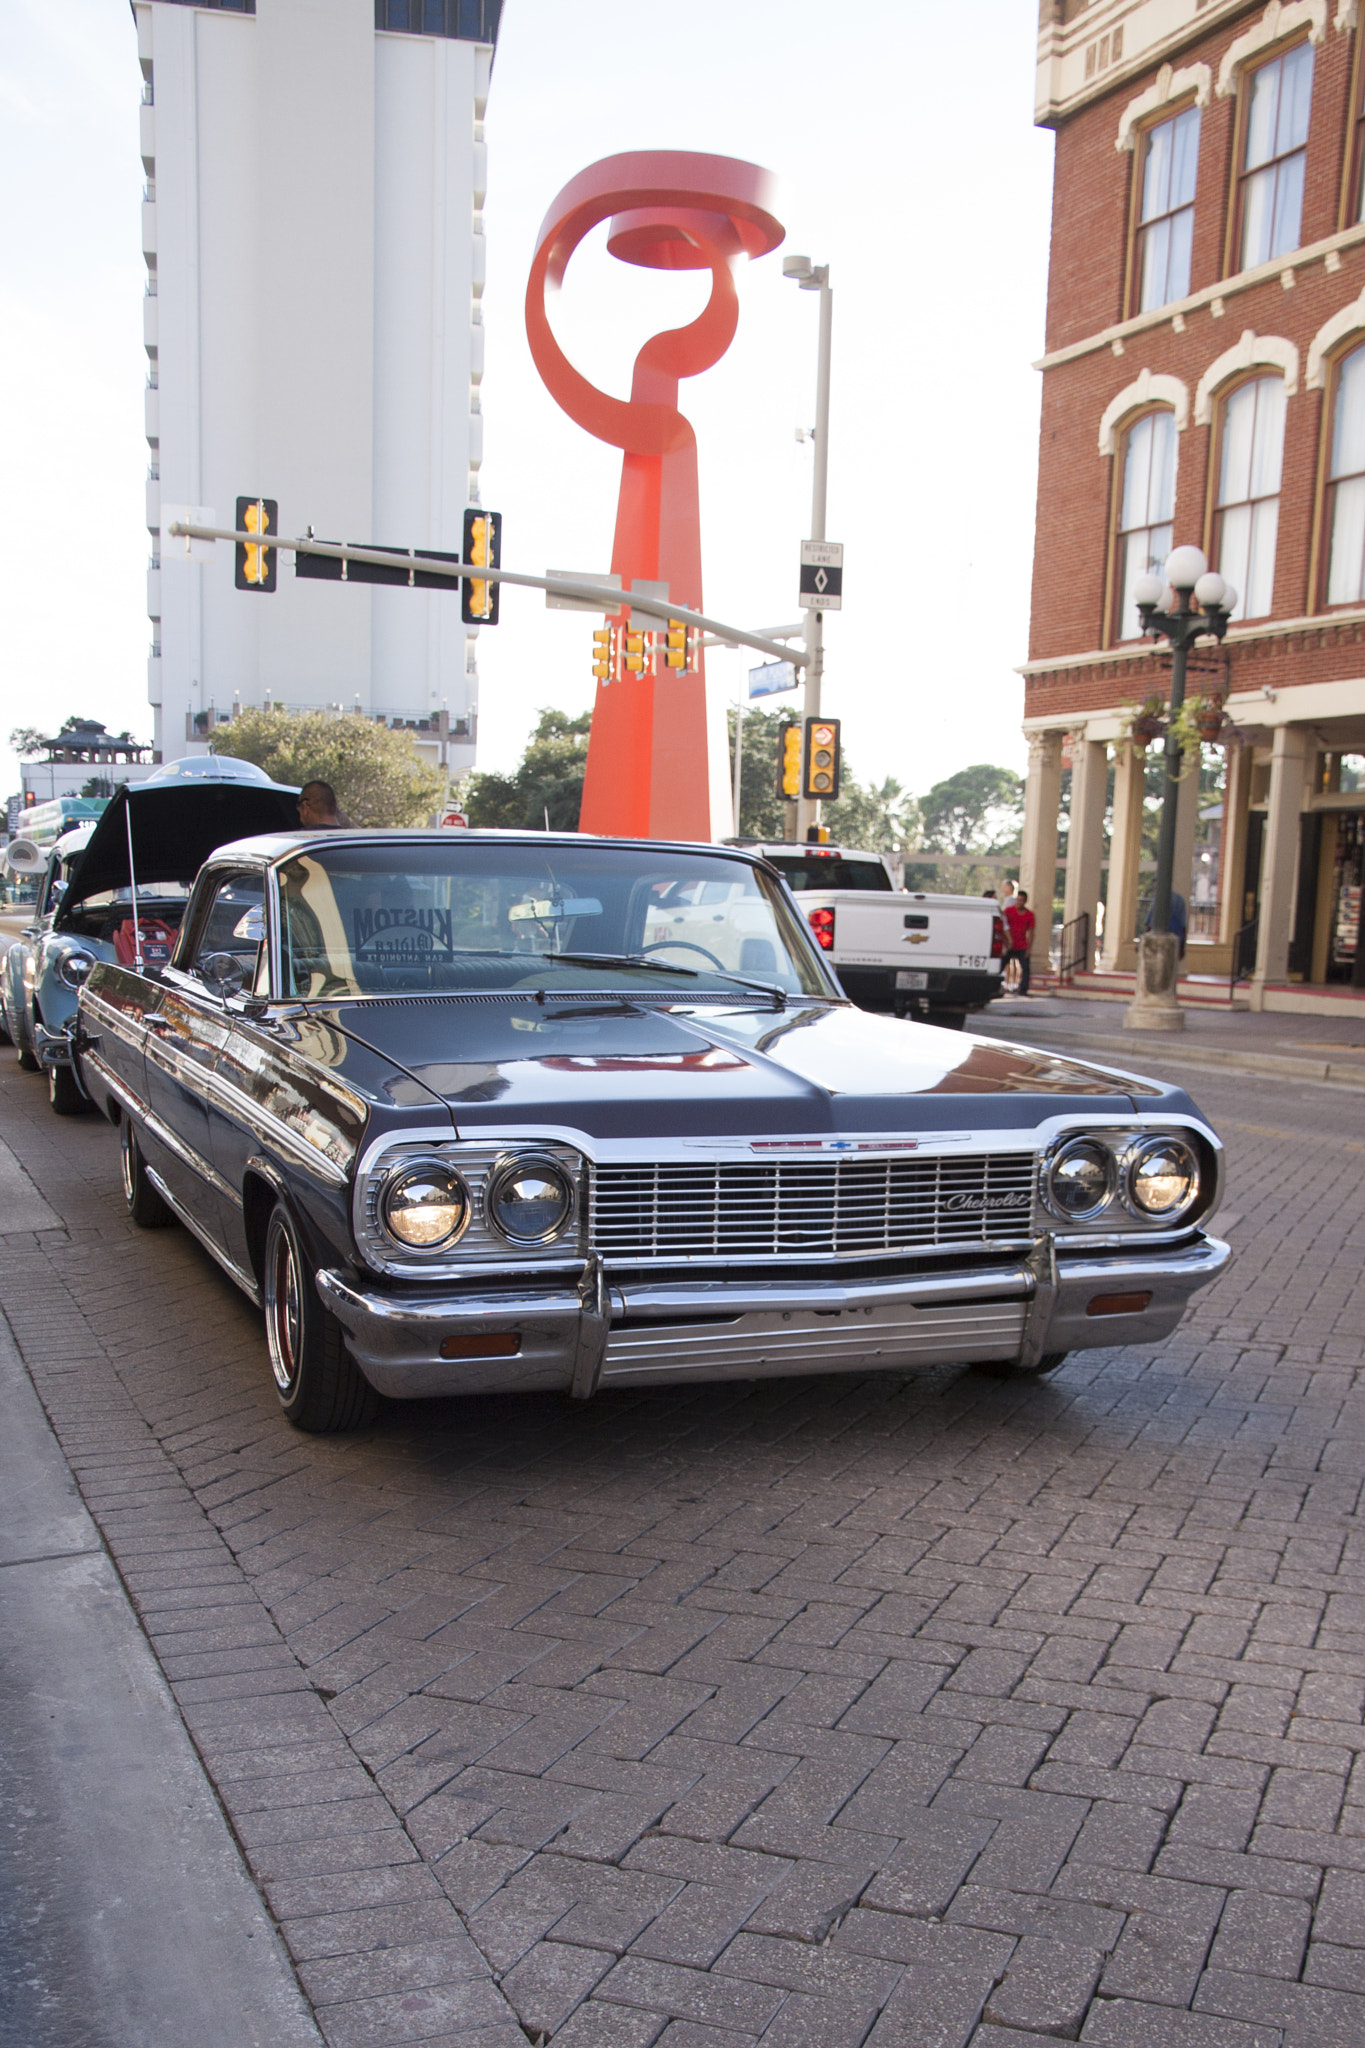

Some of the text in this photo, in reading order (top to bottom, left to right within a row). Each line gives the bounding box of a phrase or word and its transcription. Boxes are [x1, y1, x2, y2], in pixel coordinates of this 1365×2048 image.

[812, 555, 831, 563] LANE
[810, 597, 830, 606] ENDS
[8, 798, 19, 832] Hilton
[957, 955, 987, 967] T-167
[945, 1192, 1028, 1210] Chevrolet
